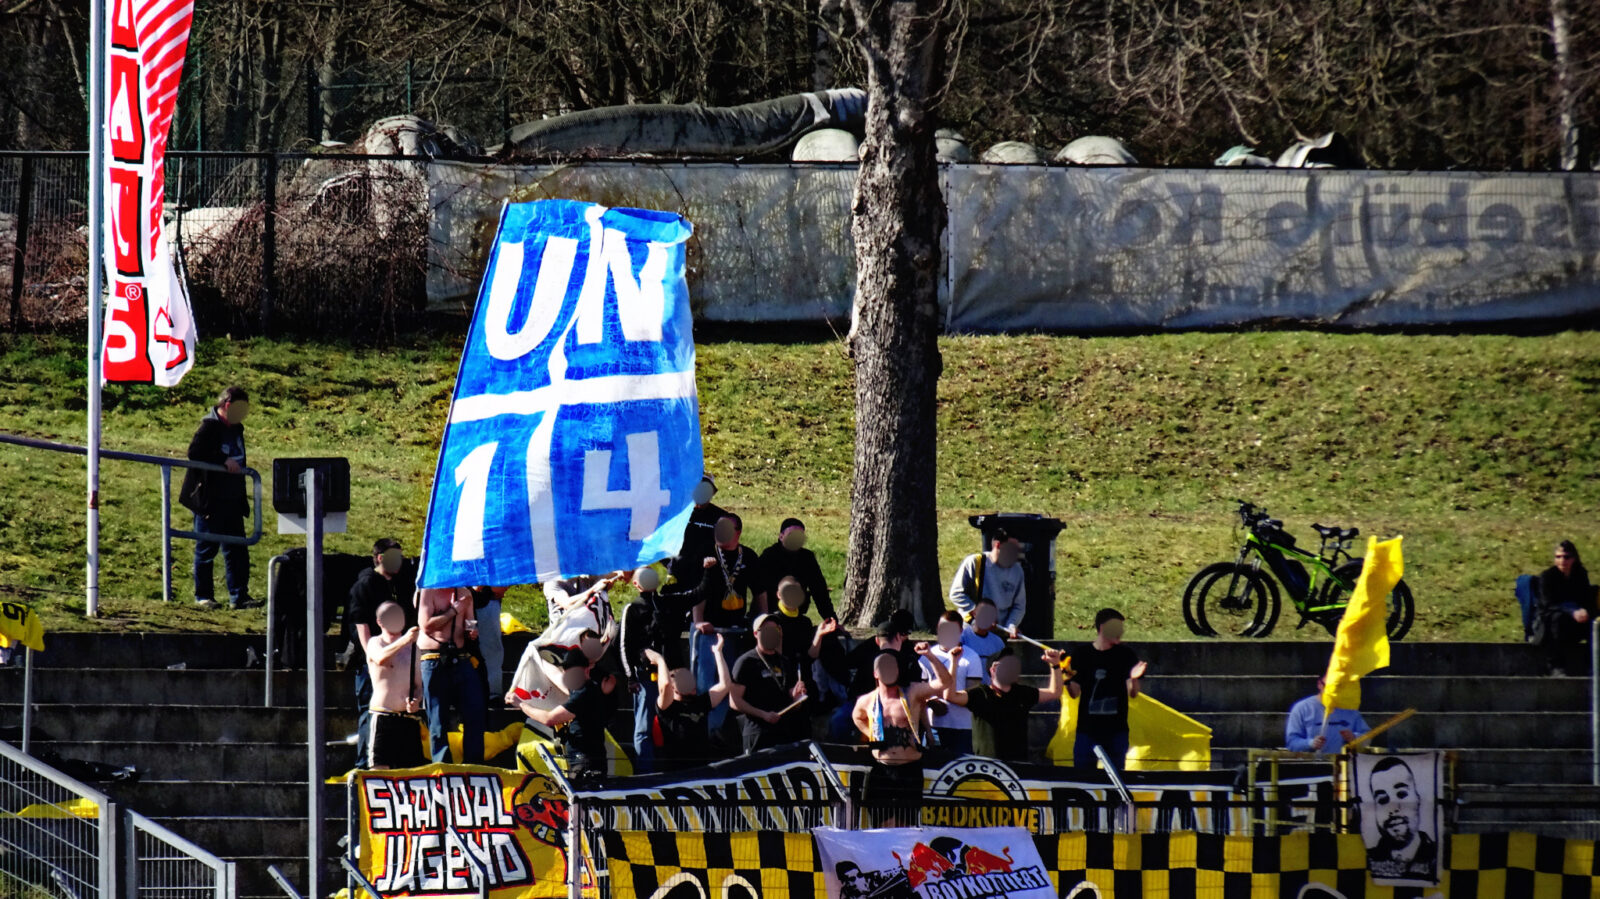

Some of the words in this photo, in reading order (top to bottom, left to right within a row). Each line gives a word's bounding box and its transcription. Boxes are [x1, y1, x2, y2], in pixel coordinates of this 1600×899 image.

[485, 228, 668, 361] UN
[452, 430, 671, 562] 14
[365, 775, 514, 830] SKANDAL
[943, 762, 1002, 786] BLOCK
[1008, 782, 1018, 792] F
[921, 804, 1040, 834] BADKURVE
[375, 832, 528, 892] JUGEND
[926, 866, 1048, 899] BOYKOTTIERT
